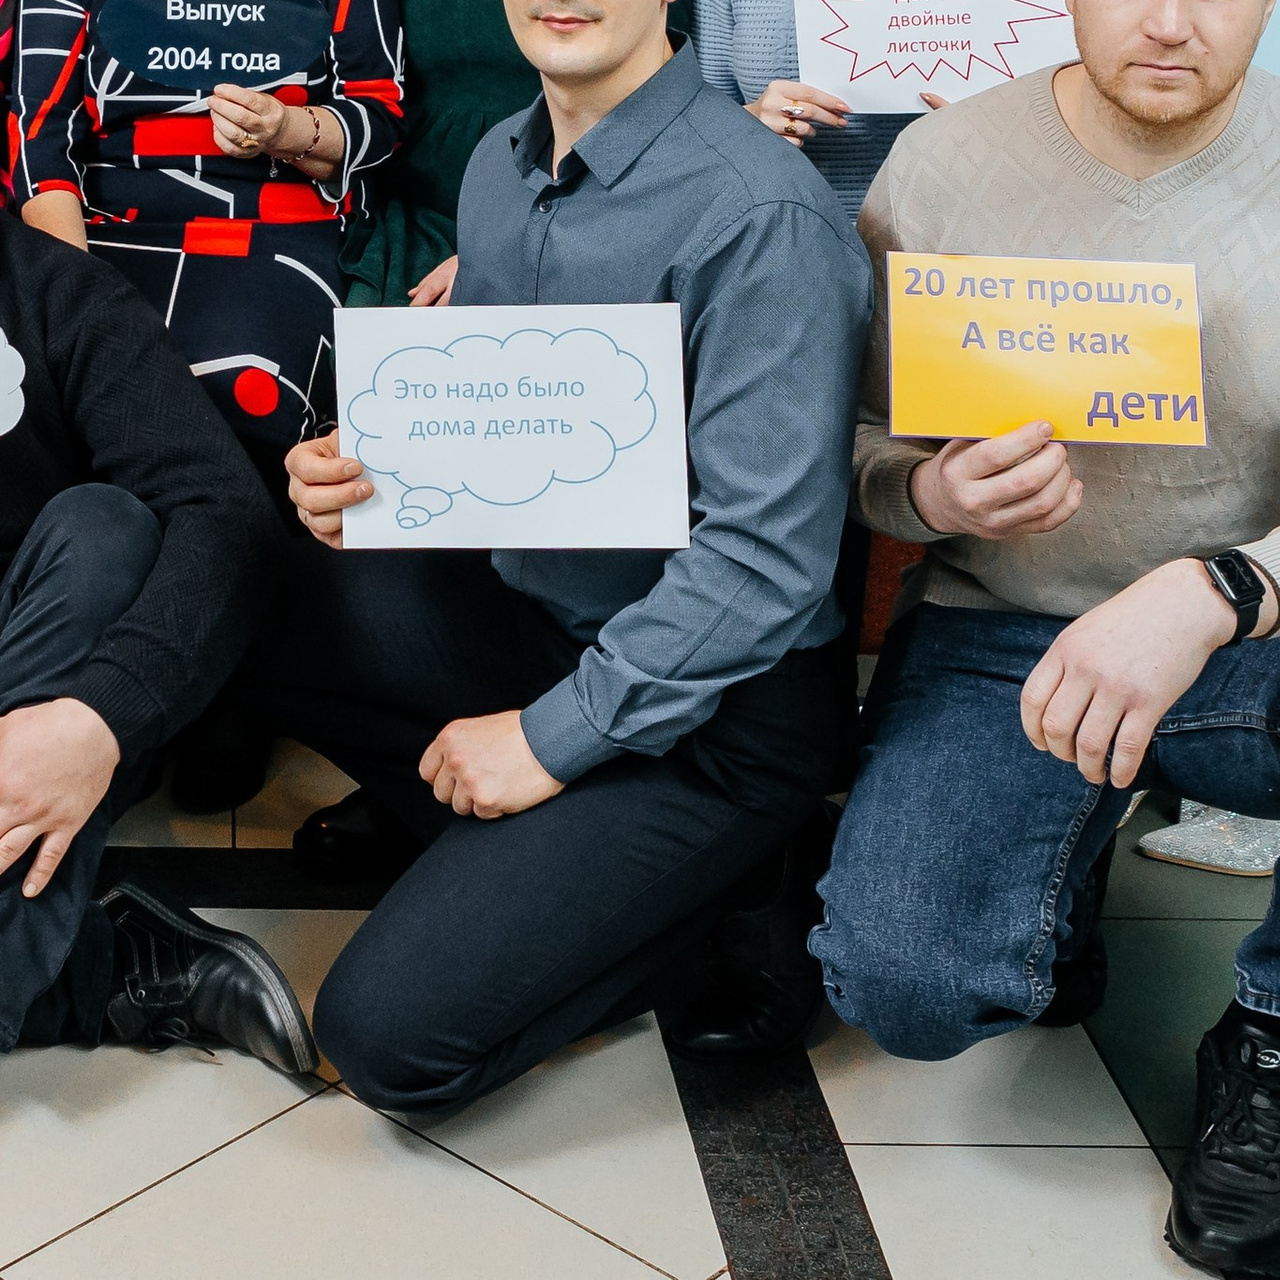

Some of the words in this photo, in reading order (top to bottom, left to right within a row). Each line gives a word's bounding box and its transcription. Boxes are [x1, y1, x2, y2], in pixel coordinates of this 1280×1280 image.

[888, 10, 972, 30] двойные
[147, 46, 212, 70] 2004
[220, 52, 281, 73] года
[887, 39, 972, 54] листочки
[904, 267, 946, 297] 20
[956, 276, 1016, 300] лет
[1027, 280, 1184, 310] прошло,
[962, 321, 987, 349] А
[998, 323, 1056, 352] всё
[1068, 331, 1130, 355] как
[393, 379, 437, 400] Это
[446, 380, 509, 403] надо
[517, 376, 585, 398] было
[1087, 391, 1199, 428] дети
[408, 419, 476, 440] дома
[484, 417, 574, 439] делать
